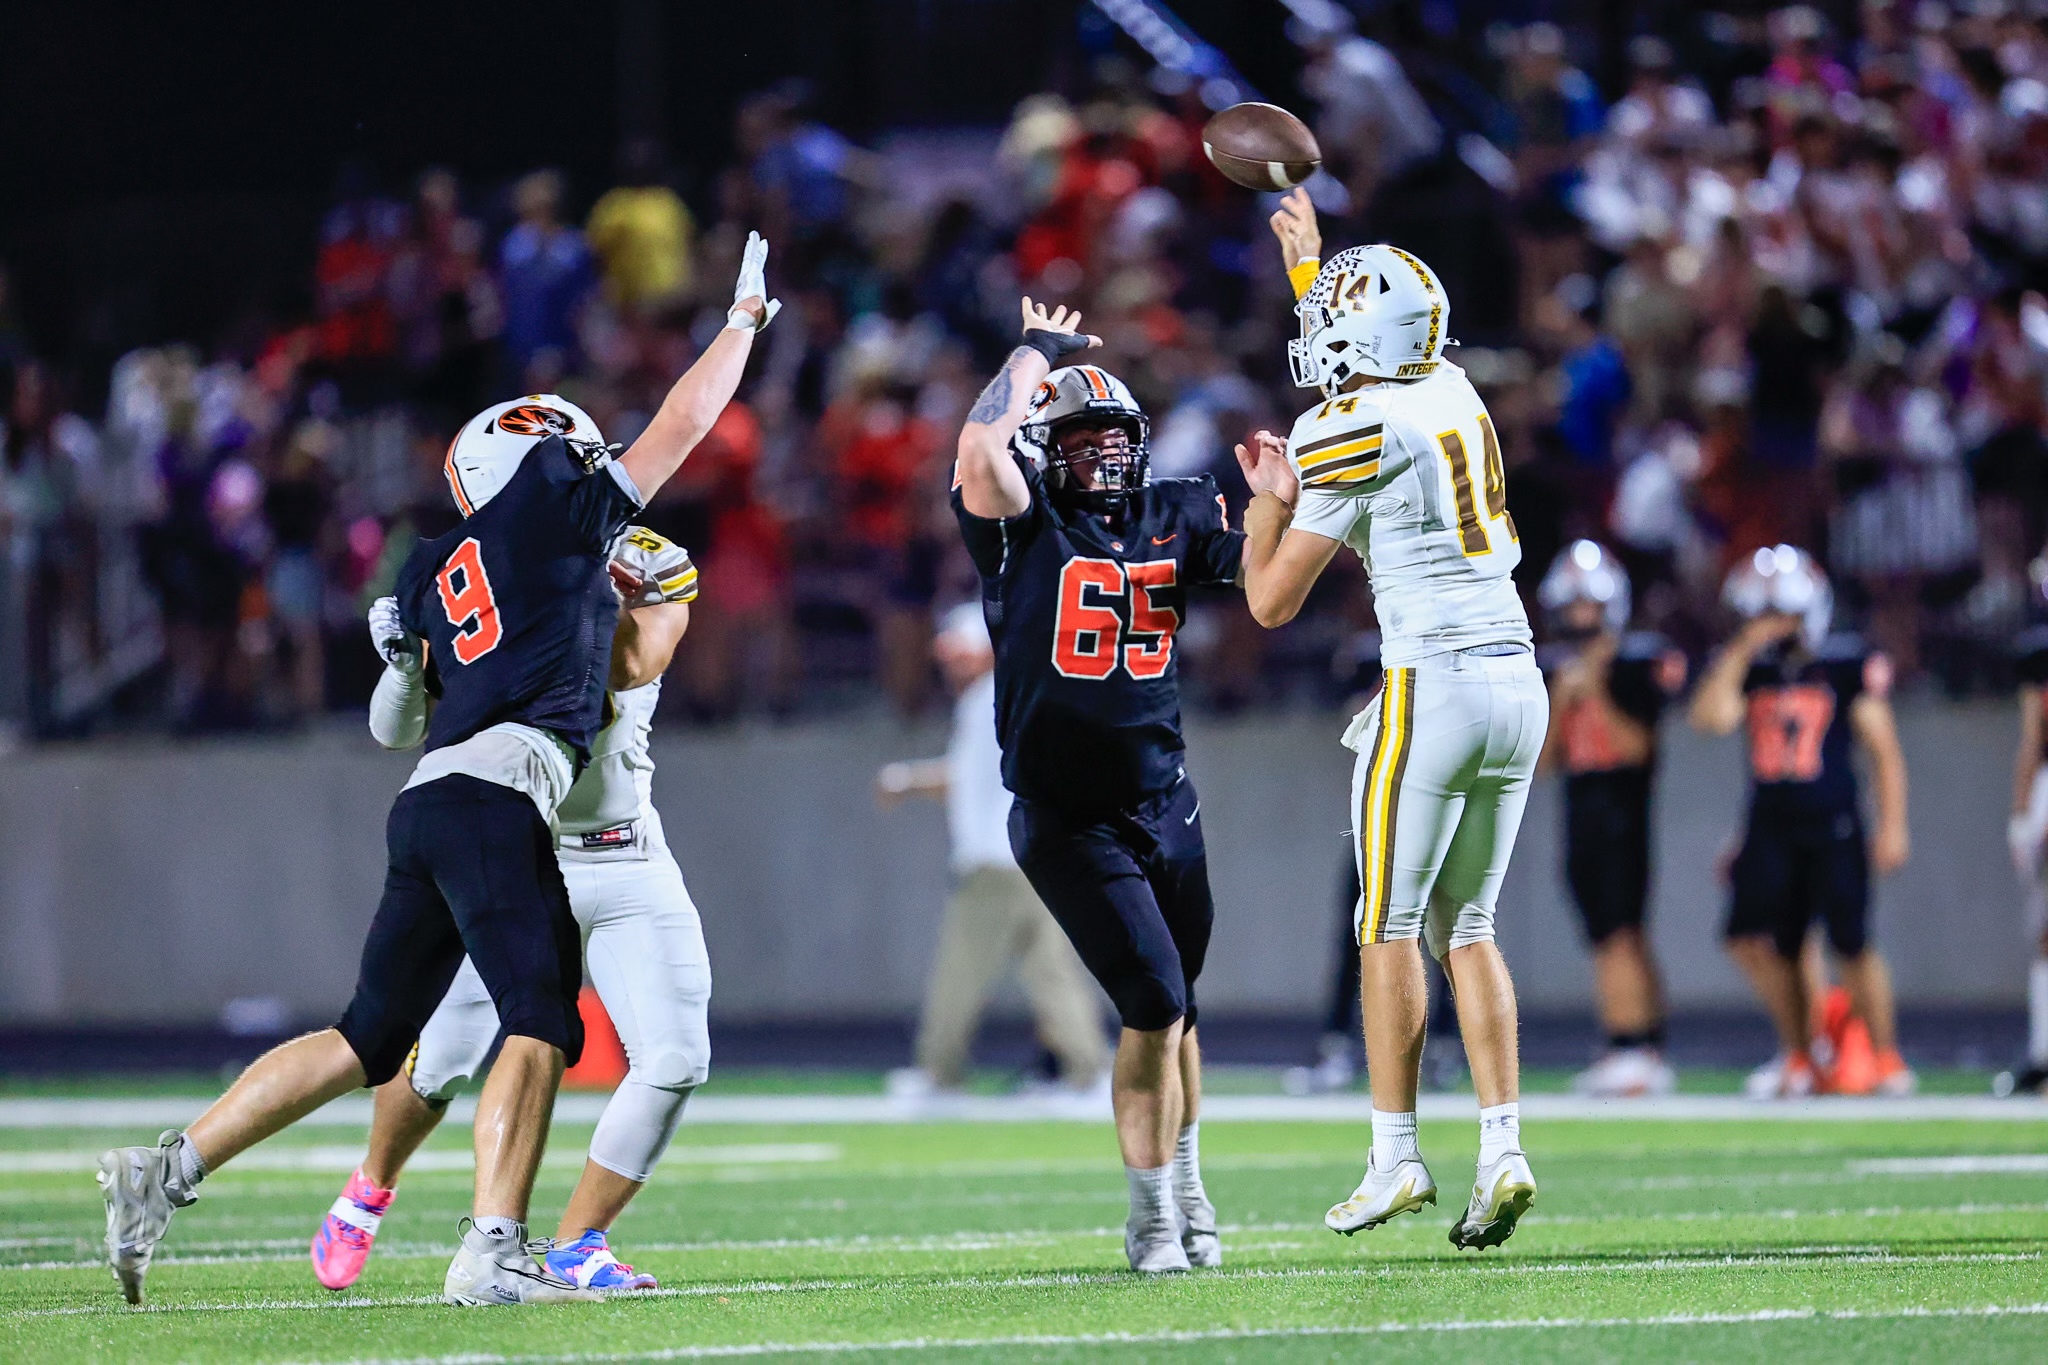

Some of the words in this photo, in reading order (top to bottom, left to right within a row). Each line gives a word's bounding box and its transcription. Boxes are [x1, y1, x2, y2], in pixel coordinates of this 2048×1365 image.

[1329, 272, 1371, 312] 14
[1316, 396, 1361, 420] 14
[1436, 413, 1519, 557] 14
[435, 536, 503, 666] 9
[1051, 555, 1181, 680] 65
